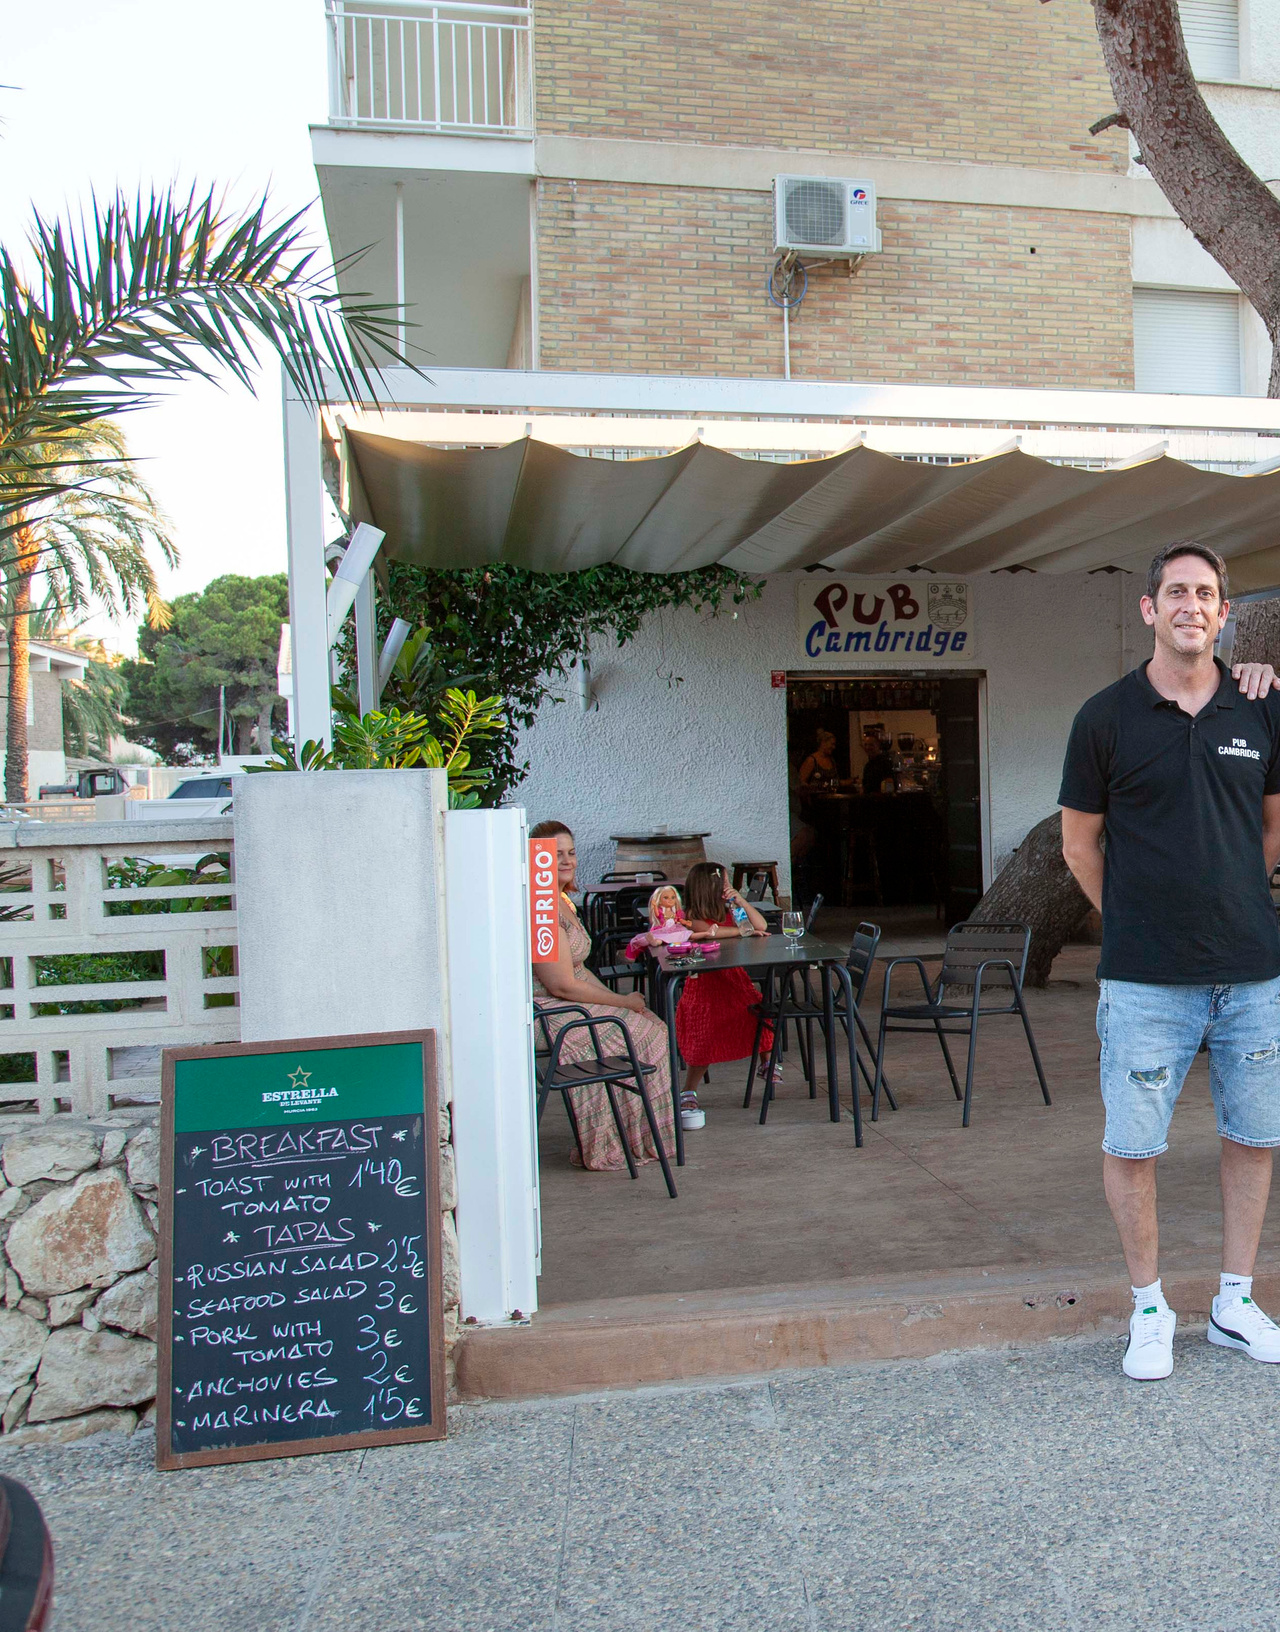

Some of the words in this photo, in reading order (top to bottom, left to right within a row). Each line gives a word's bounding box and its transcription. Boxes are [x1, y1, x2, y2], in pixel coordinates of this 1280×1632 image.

[813, 583, 919, 628] PUB
[805, 620, 967, 657] Cambridge
[1218, 746, 1261, 760] CAMBRIDGE
[1232, 738, 1247, 748] PUB
[534, 850, 554, 925] FRIGO
[262, 1087, 339, 1102] ESTRELLA
[211, 1124, 383, 1162] BREAKFAST
[195, 1175, 274, 1197] TOAST
[285, 1173, 332, 1190] WITH
[222, 1195, 332, 1217] TOMATO
[253, 1218, 356, 1247] TAPAS
[187, 1258, 287, 1289] RUSSIAN
[292, 1252, 379, 1275] SALAD
[187, 1292, 286, 1319] SEAFOOD
[294, 1281, 368, 1304] SALAD
[190, 1323, 258, 1346] PORK
[272, 1320, 322, 1338] WITH
[232, 1340, 334, 1365] TOMATO
[187, 1367, 338, 1402] ANCHOVIES
[193, 1399, 342, 1431] MARINERA
